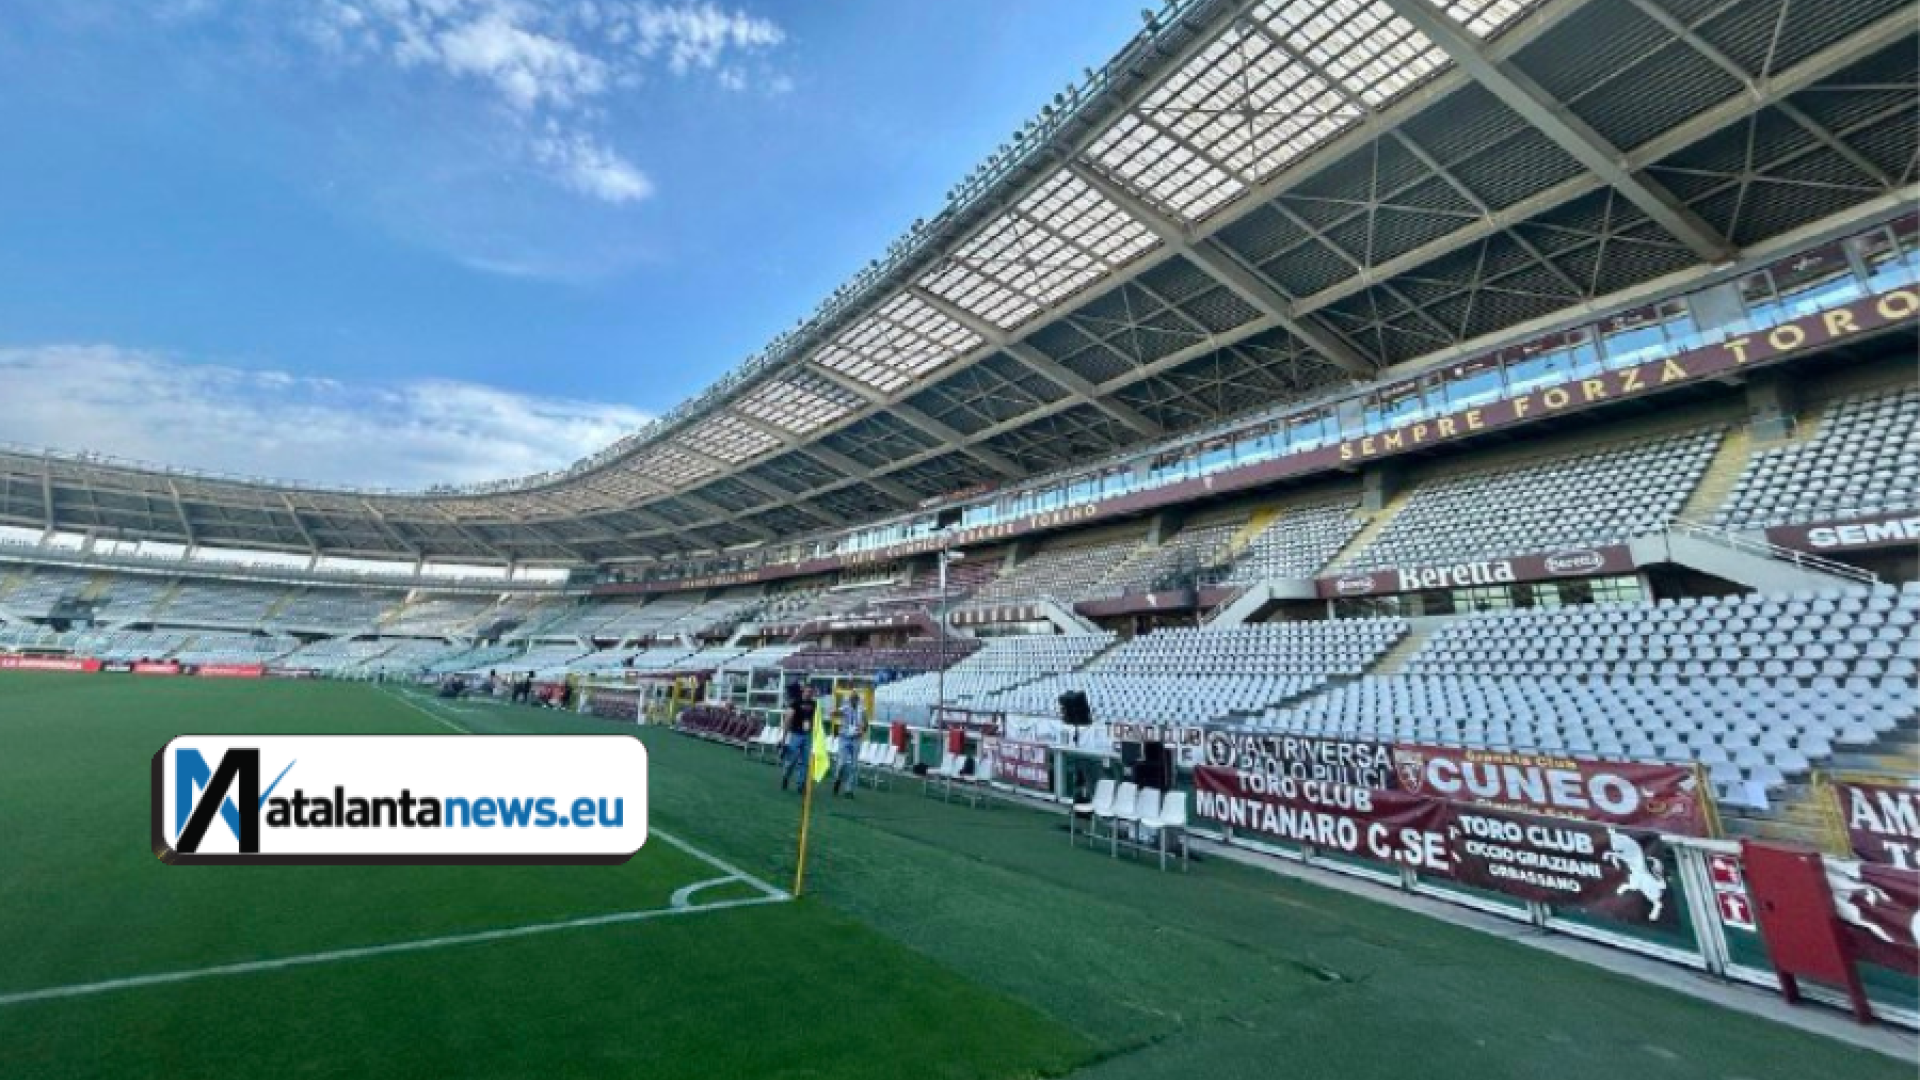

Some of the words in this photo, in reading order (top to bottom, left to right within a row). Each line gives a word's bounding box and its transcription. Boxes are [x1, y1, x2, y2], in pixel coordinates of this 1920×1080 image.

[1340, 410, 1484, 460] SEMPRE
[1513, 358, 1688, 418] FORZA
[1724, 291, 1919, 363] TORO
[1030, 504, 1097, 529] TORINO
[1399, 560, 1515, 591] Beretta
[1236, 769, 1298, 799] TORO
[1302, 780, 1373, 813] CLUB
[1426, 757, 1640, 815] CUNEO
[1196, 788, 1358, 852] MONTANARO
[1458, 815, 1522, 843] TORO
[1526, 825, 1594, 854] CLUB
